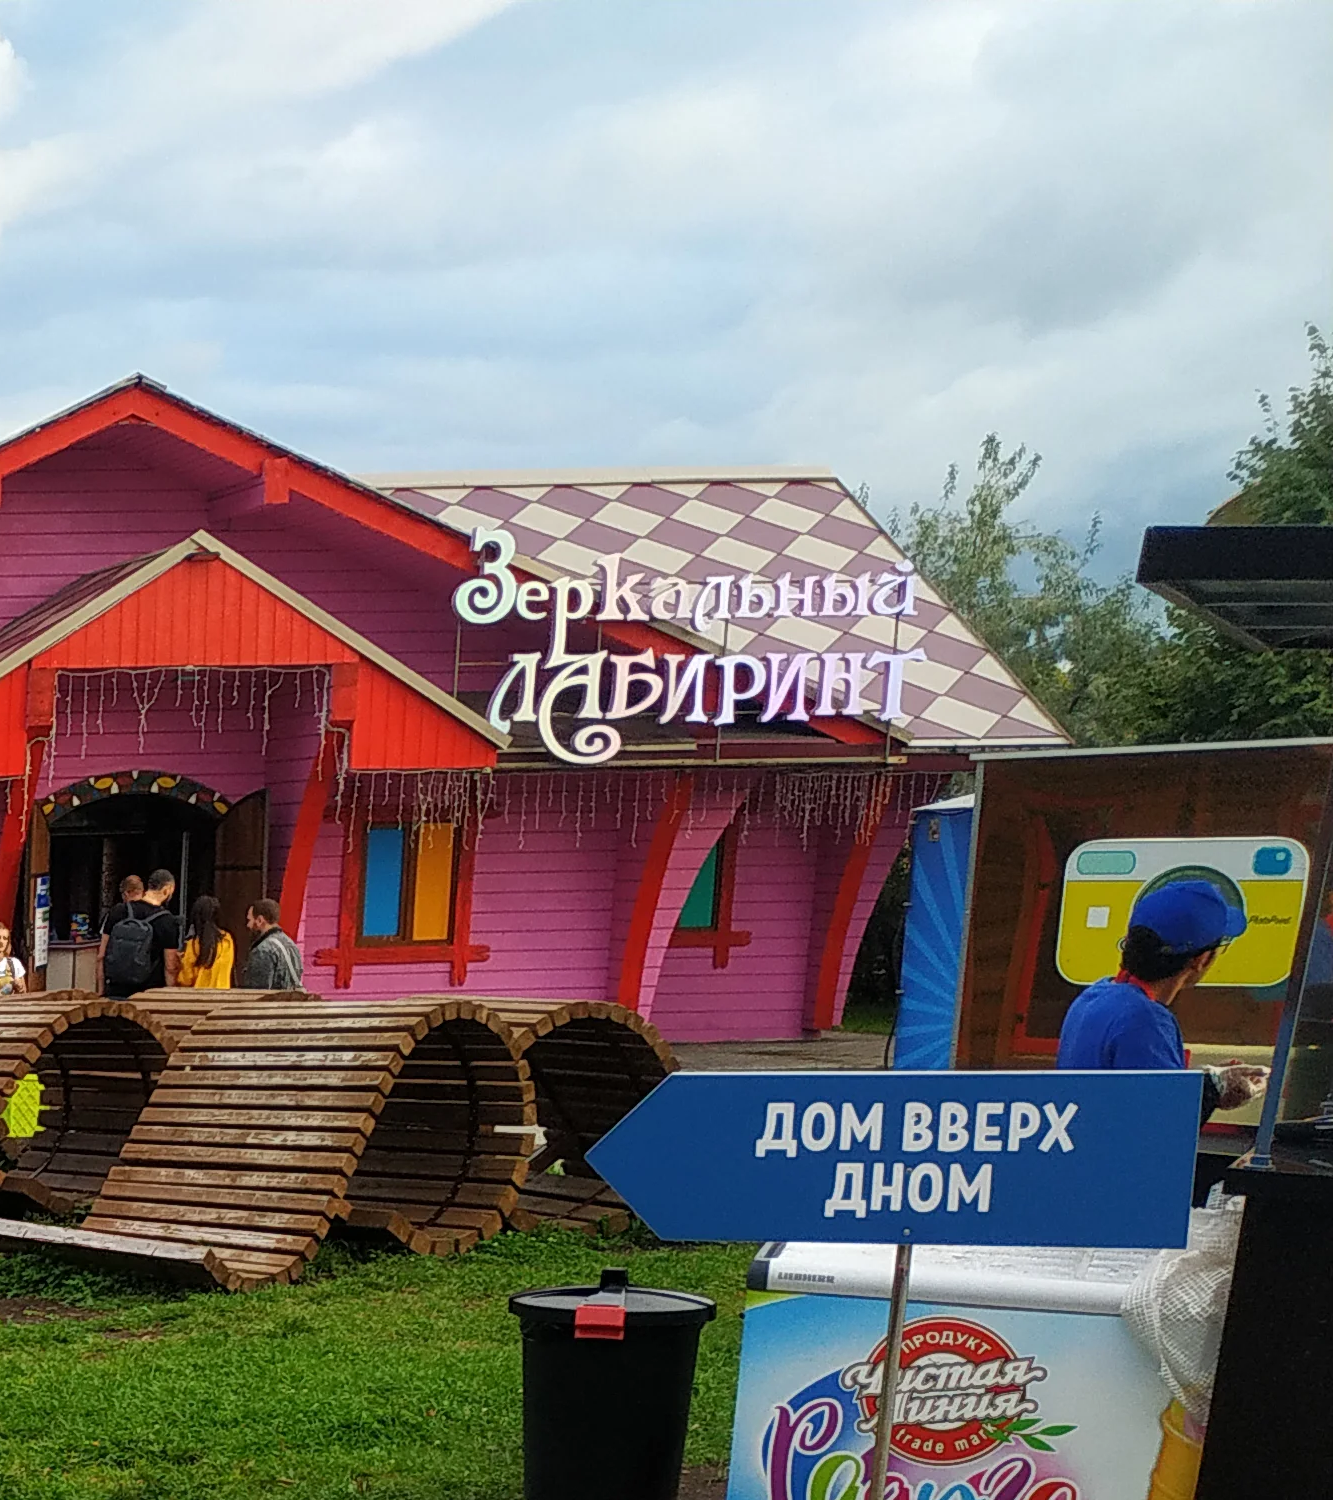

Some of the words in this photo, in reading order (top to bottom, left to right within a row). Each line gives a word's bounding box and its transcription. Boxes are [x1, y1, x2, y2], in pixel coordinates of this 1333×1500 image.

[453, 527, 919, 666] Зеркальный
[487, 648, 927, 764] ЛАБИРИНТ
[755, 1101, 884, 1158] ДОМ
[901, 1101, 1079, 1153] ВВЕРХ
[824, 1162, 993, 1218] ДНОМ
[901, 1330, 993, 1355] ПРОДУКТ
[894, 1427, 945, 1454] trade
[953, 1423, 998, 1452] mark
